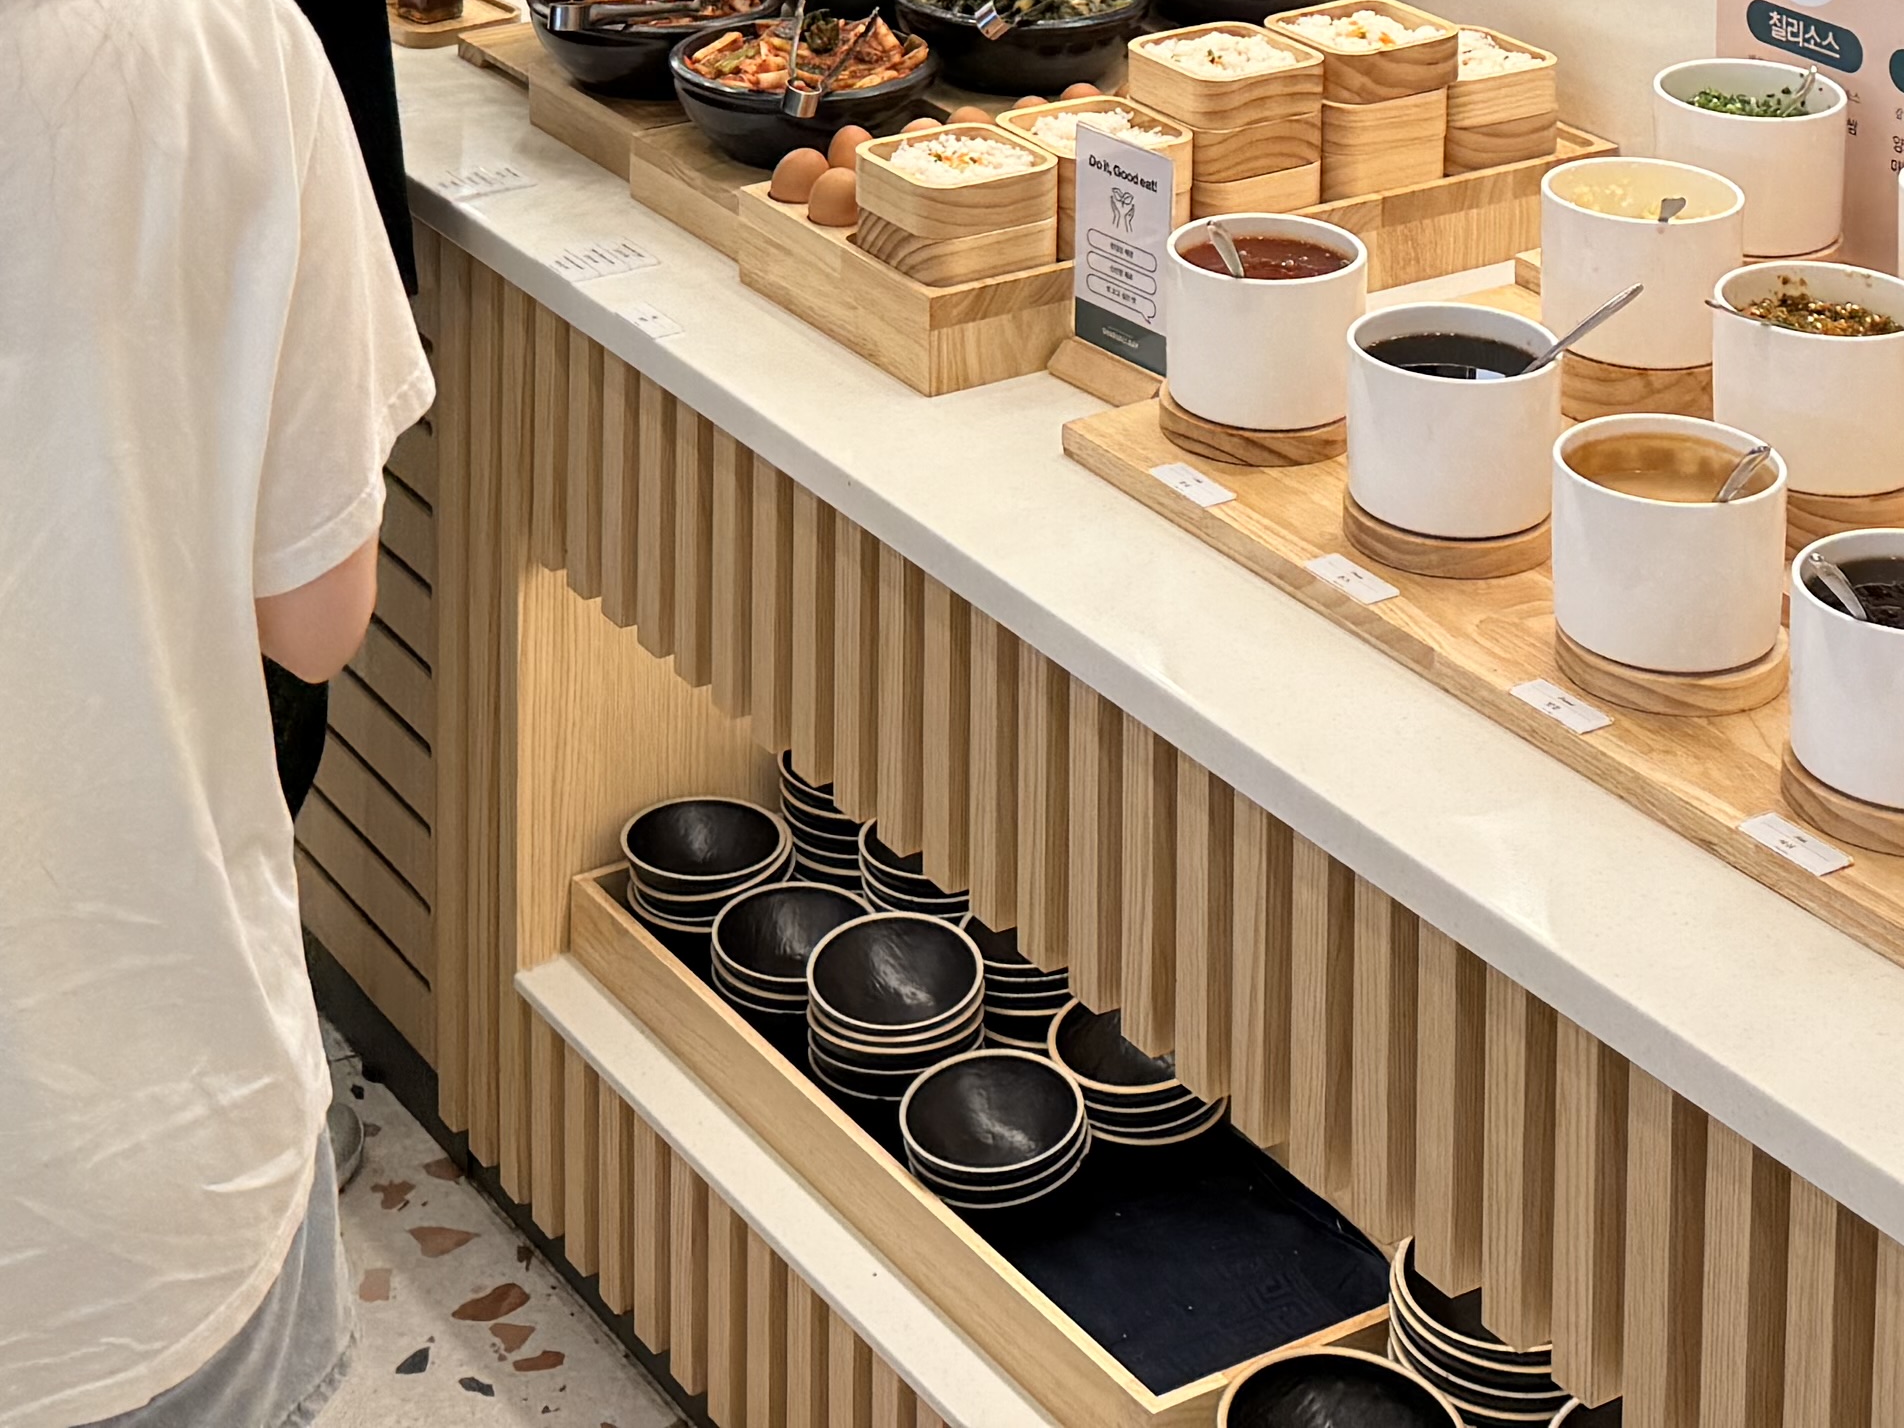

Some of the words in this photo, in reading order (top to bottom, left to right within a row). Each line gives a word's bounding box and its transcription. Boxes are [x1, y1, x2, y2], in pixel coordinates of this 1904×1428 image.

[1768, 10, 1841, 59] 칠리소스
[1088, 154, 1103, 170] Do
[1113, 164, 1139, 186] Good
